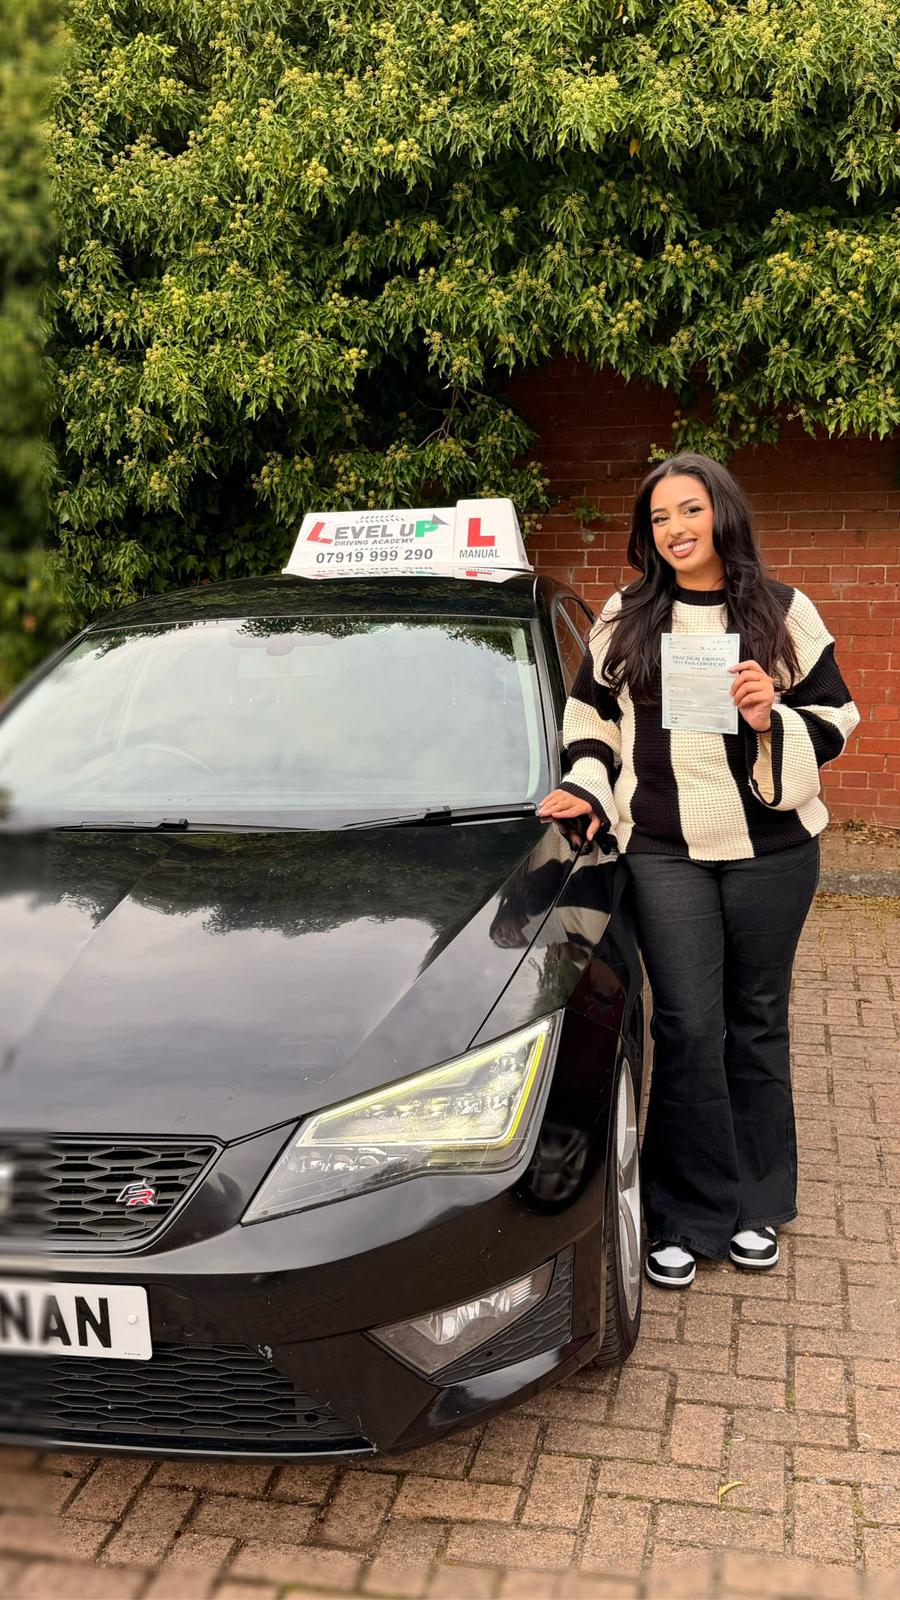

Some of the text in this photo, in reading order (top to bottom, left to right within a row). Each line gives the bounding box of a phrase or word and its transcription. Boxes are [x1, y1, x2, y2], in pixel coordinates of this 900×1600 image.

[306, 519, 439, 544] LEVEL UP
[467, 517, 496, 547] L
[316, 548, 433, 564] 07919 999 290
[459, 549, 500, 559] MANUAL
